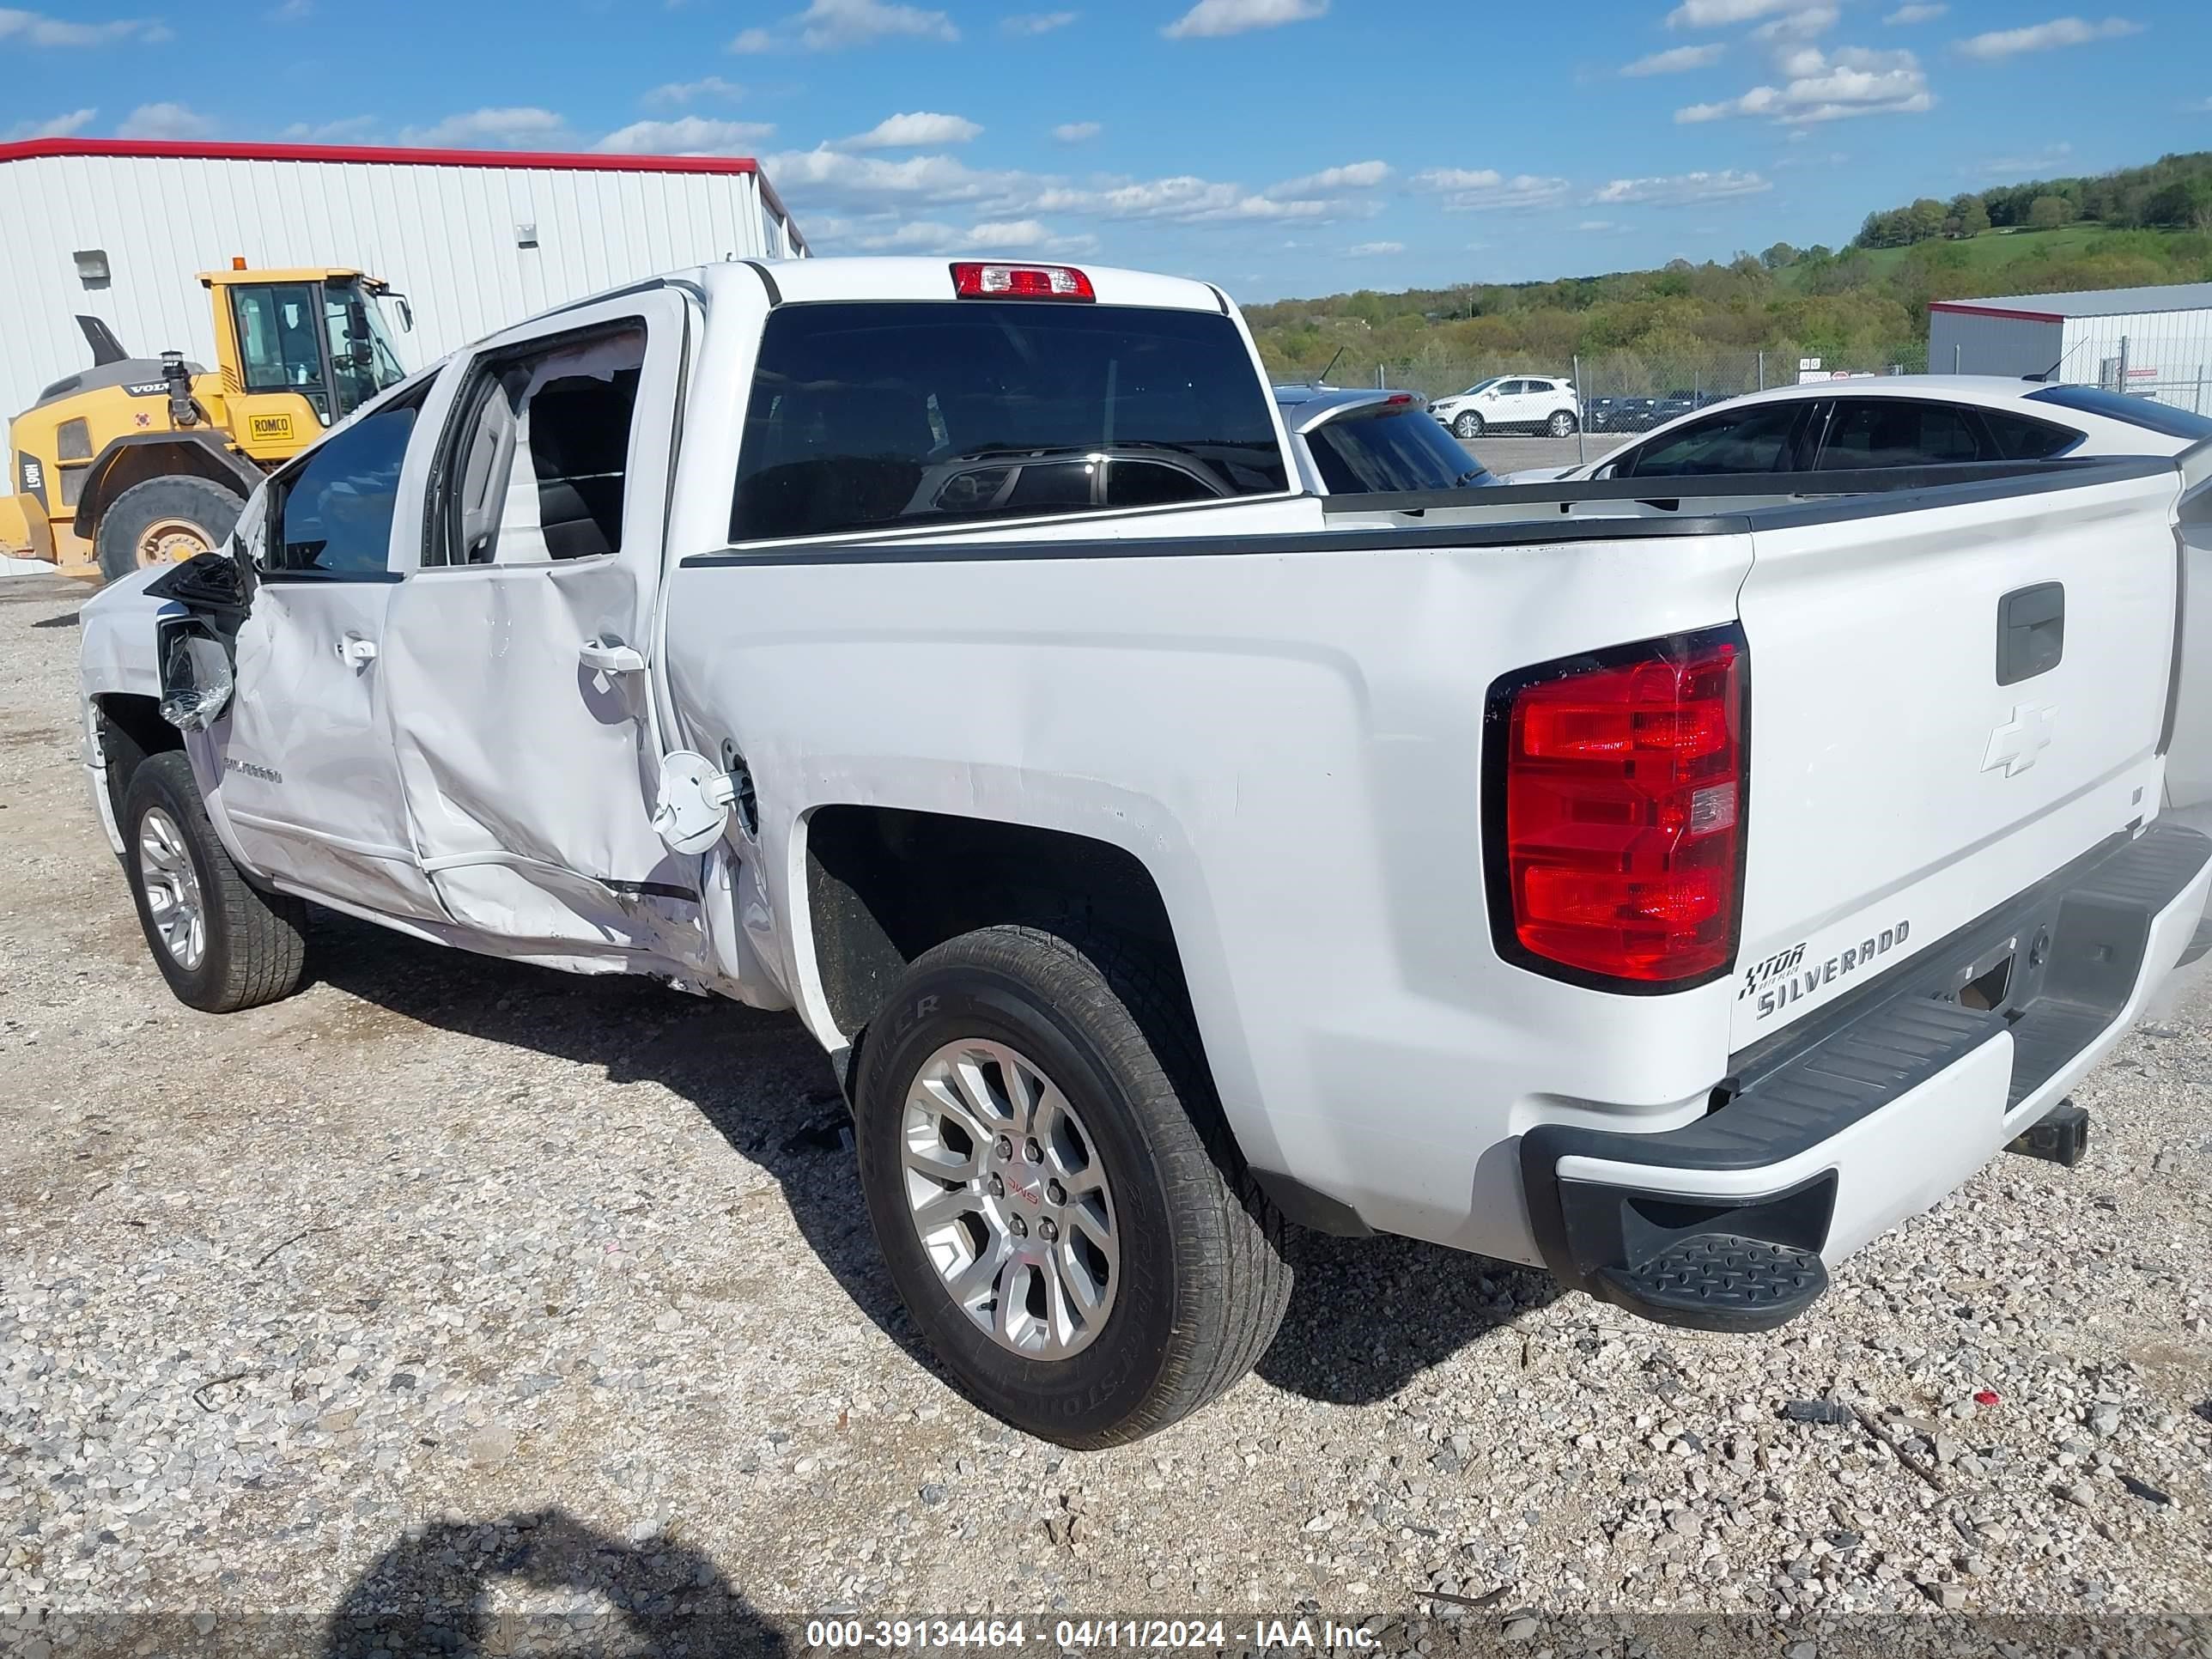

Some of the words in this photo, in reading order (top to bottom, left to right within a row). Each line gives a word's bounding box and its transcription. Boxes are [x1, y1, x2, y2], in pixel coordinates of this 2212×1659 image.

[130, 382, 170, 393] VOLV
[254, 418, 289, 432] ROMCO
[25, 464, 41, 489] L90H
[1757, 920, 1910, 1020] SILVERADO
[1008, 1176, 1038, 1204] GMC
